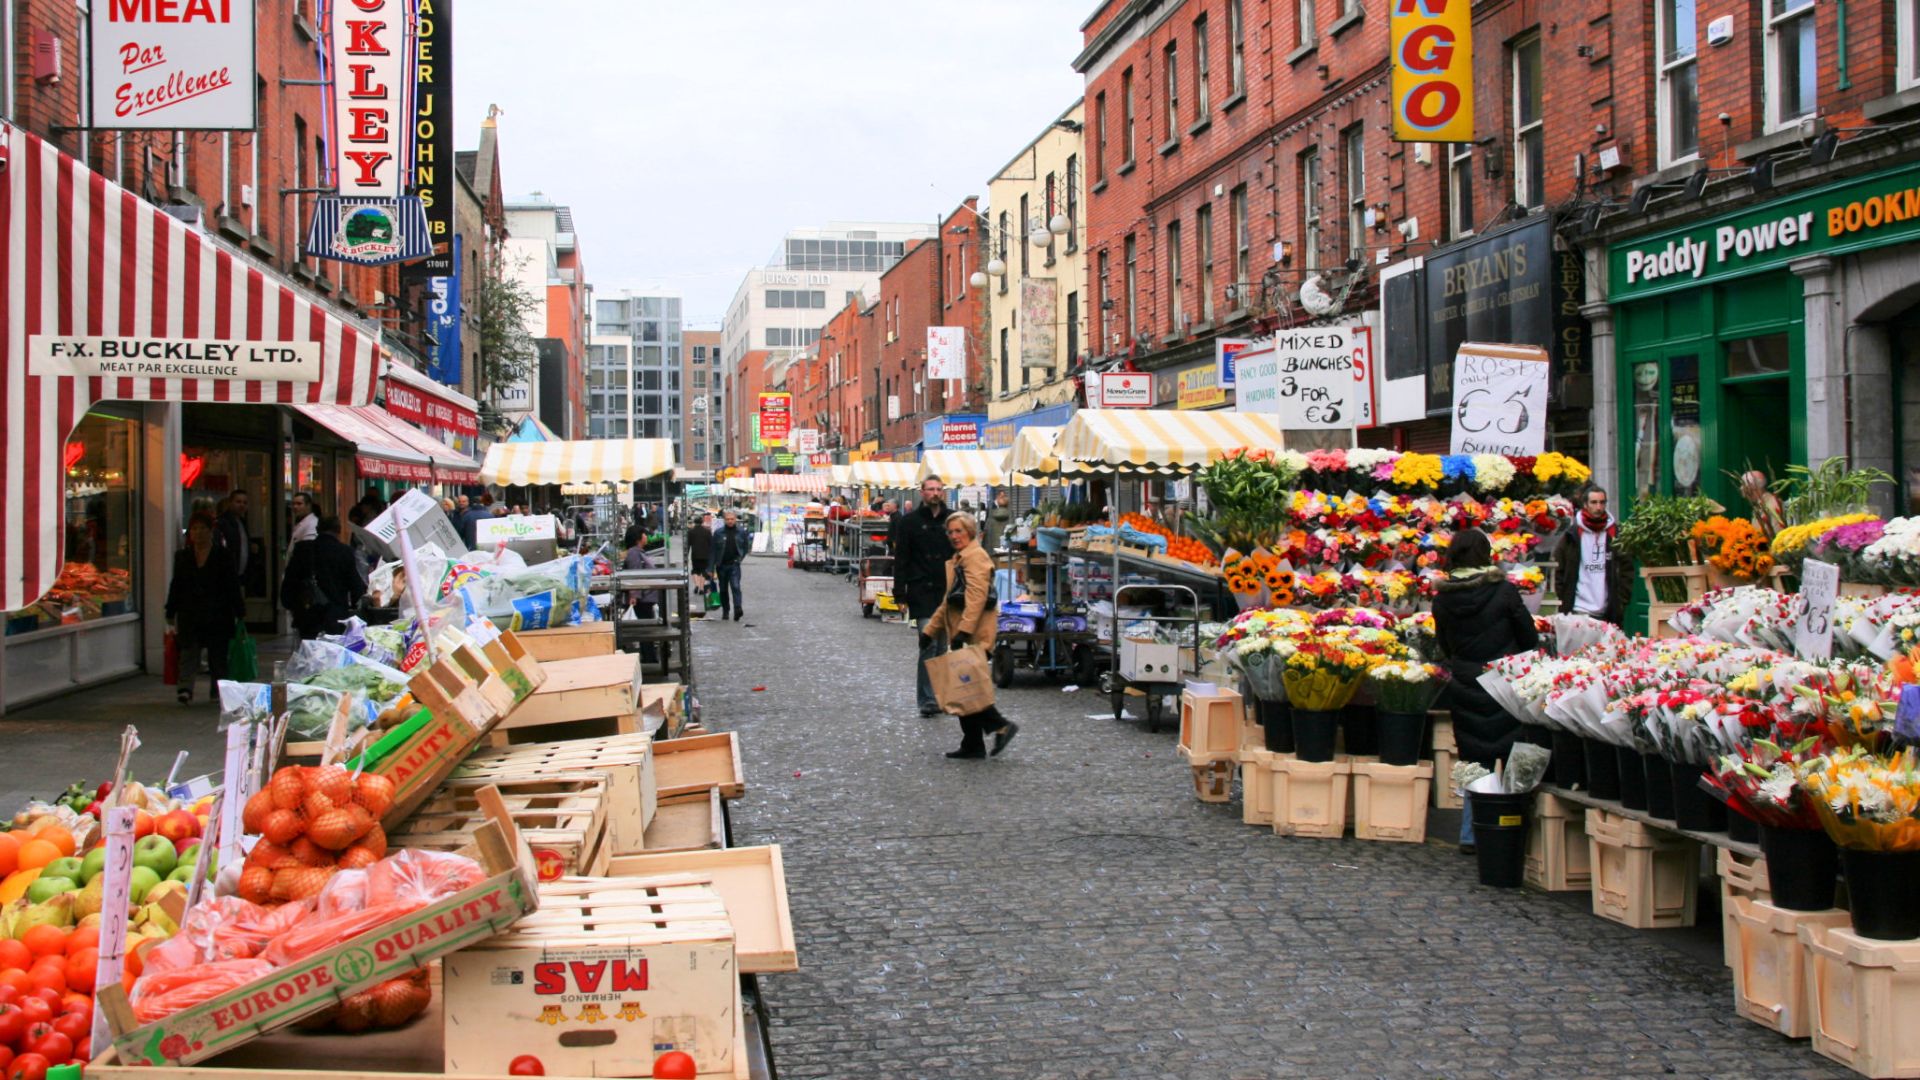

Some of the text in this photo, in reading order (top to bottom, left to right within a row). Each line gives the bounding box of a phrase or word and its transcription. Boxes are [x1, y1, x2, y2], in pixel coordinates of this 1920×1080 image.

[109, 0, 230, 23] MEAT
[119, 42, 166, 74] Par
[115, 67, 231, 117] Excellence
[346, 0, 390, 186] KLEY
[417, 94, 434, 207] JOHNS
[350, 242, 397, 255] BUCKLEY
[1627, 211, 1814, 283] Paddy Power
[1443, 243, 1527, 297] BRYAN'S
[1561, 254, 1581, 373] KEYS CUT
[51, 341, 303, 363] F.X. BUCKLEY LTD.
[1281, 334, 1344, 350] MIXED
[100, 362, 239, 376] MEAT PAR EXCELLENCE
[1281, 356, 1352, 373] BUNCHES
[1281, 377, 1330, 402] 3 FOR
[1461, 376, 1489, 385] ONLY
[1306, 398, 1343, 424] €5
[1458, 385, 1532, 434] €5
[942, 423, 977, 432] Internet
[943, 433, 977, 441] Access
[1461, 438, 1526, 456] BUNCH
[373, 889, 502, 962] QUALITY
[535, 959, 648, 995] MAS
[212, 965, 333, 1031] EUROPE
[561, 993, 622, 1003] HERMANOS
